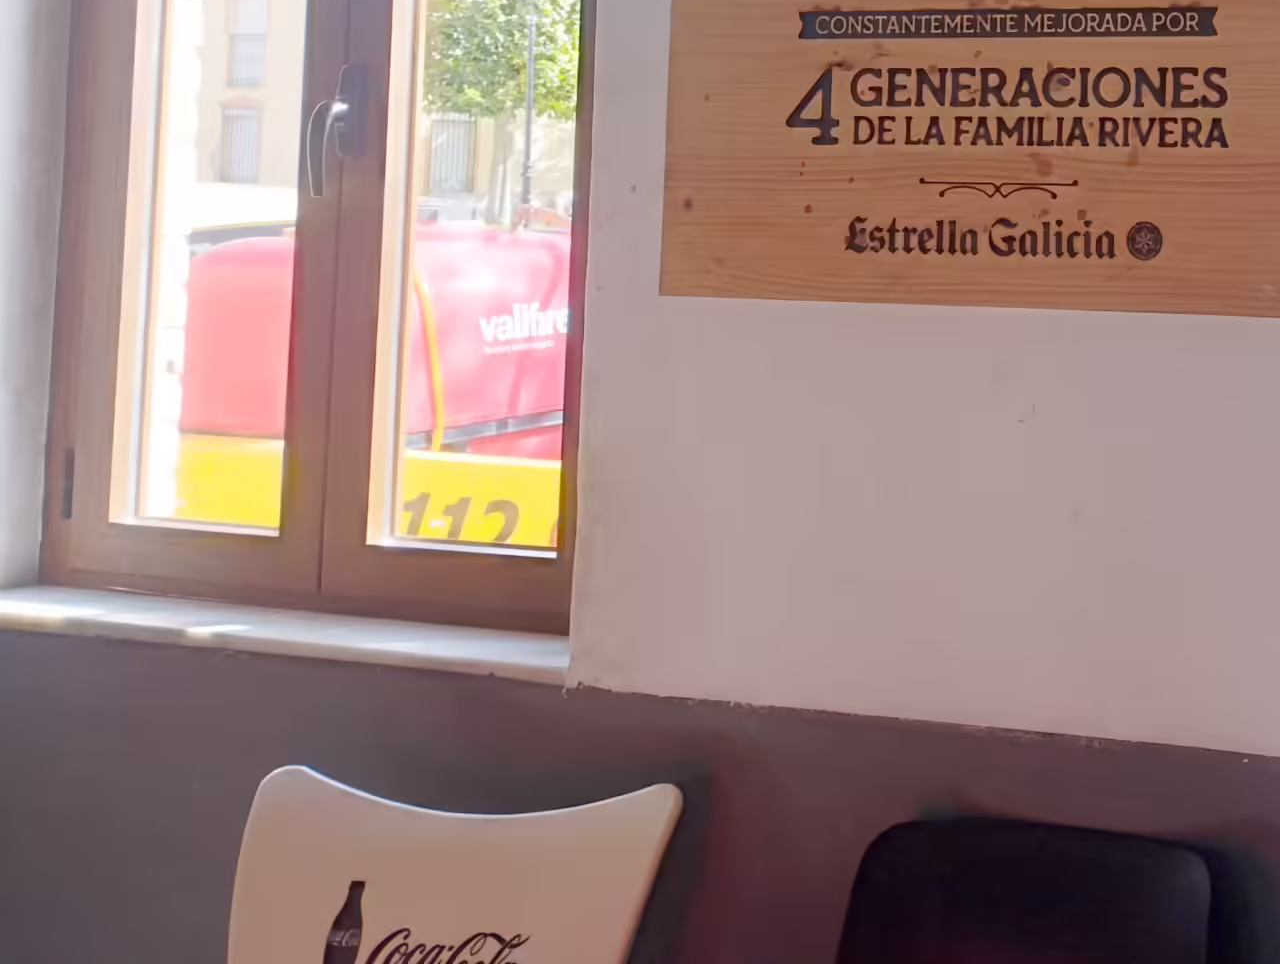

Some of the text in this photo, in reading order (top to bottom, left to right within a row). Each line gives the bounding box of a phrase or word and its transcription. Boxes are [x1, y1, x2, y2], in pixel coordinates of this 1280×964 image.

[815, 12, 1200, 35] CONSTANTEMENTE MEJORADA POR
[785, 67, 1228, 145] 4 GENERACIONES
[853, 116, 1229, 148] DE LA FAMILIA RIVERA
[845, 216, 1117, 259] Estrella Galicia
[403, 492, 519, 542] 112
[365, 928, 532, 964] Coca-Cl
